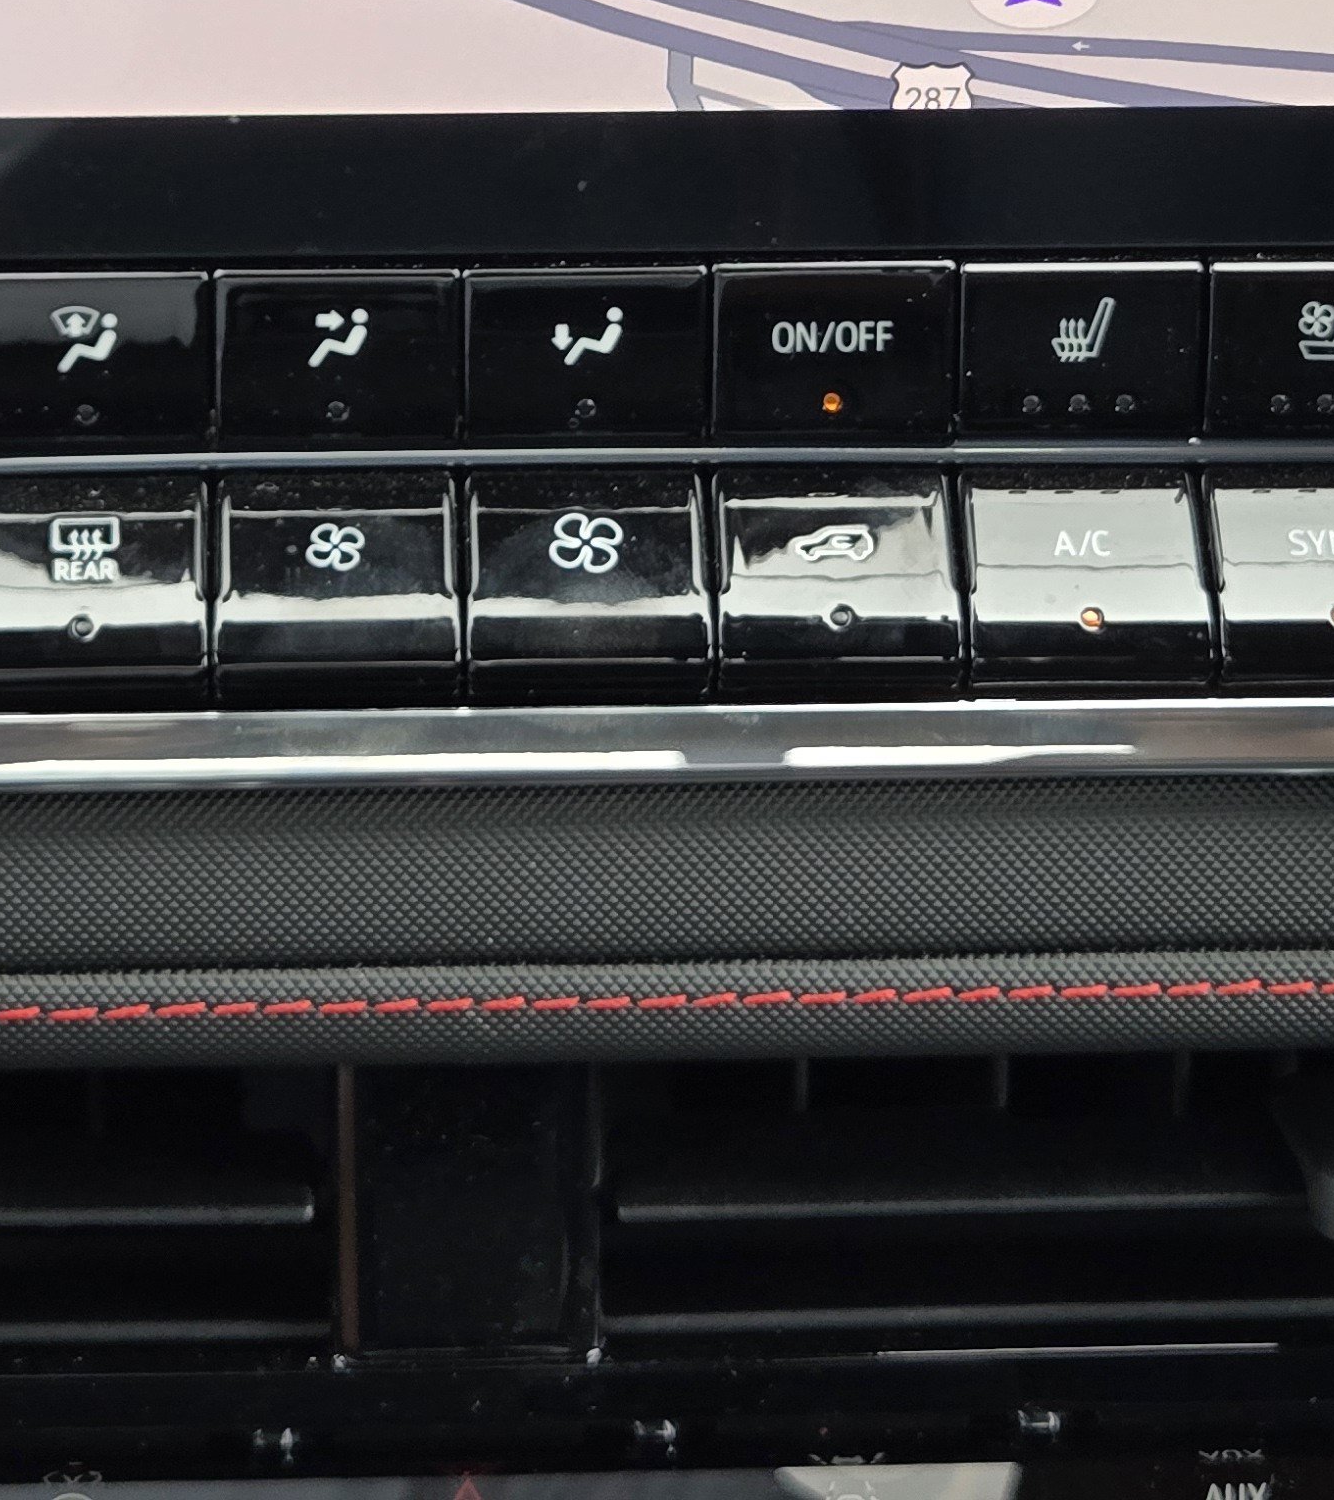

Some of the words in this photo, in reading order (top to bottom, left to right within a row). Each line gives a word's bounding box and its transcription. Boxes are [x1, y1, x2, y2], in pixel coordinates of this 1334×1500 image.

[904, 86, 961, 109] 287
[771, 320, 894, 354] ON/OFF
[1053, 529, 1112, 558] A/C
[53, 557, 118, 582] REAR
